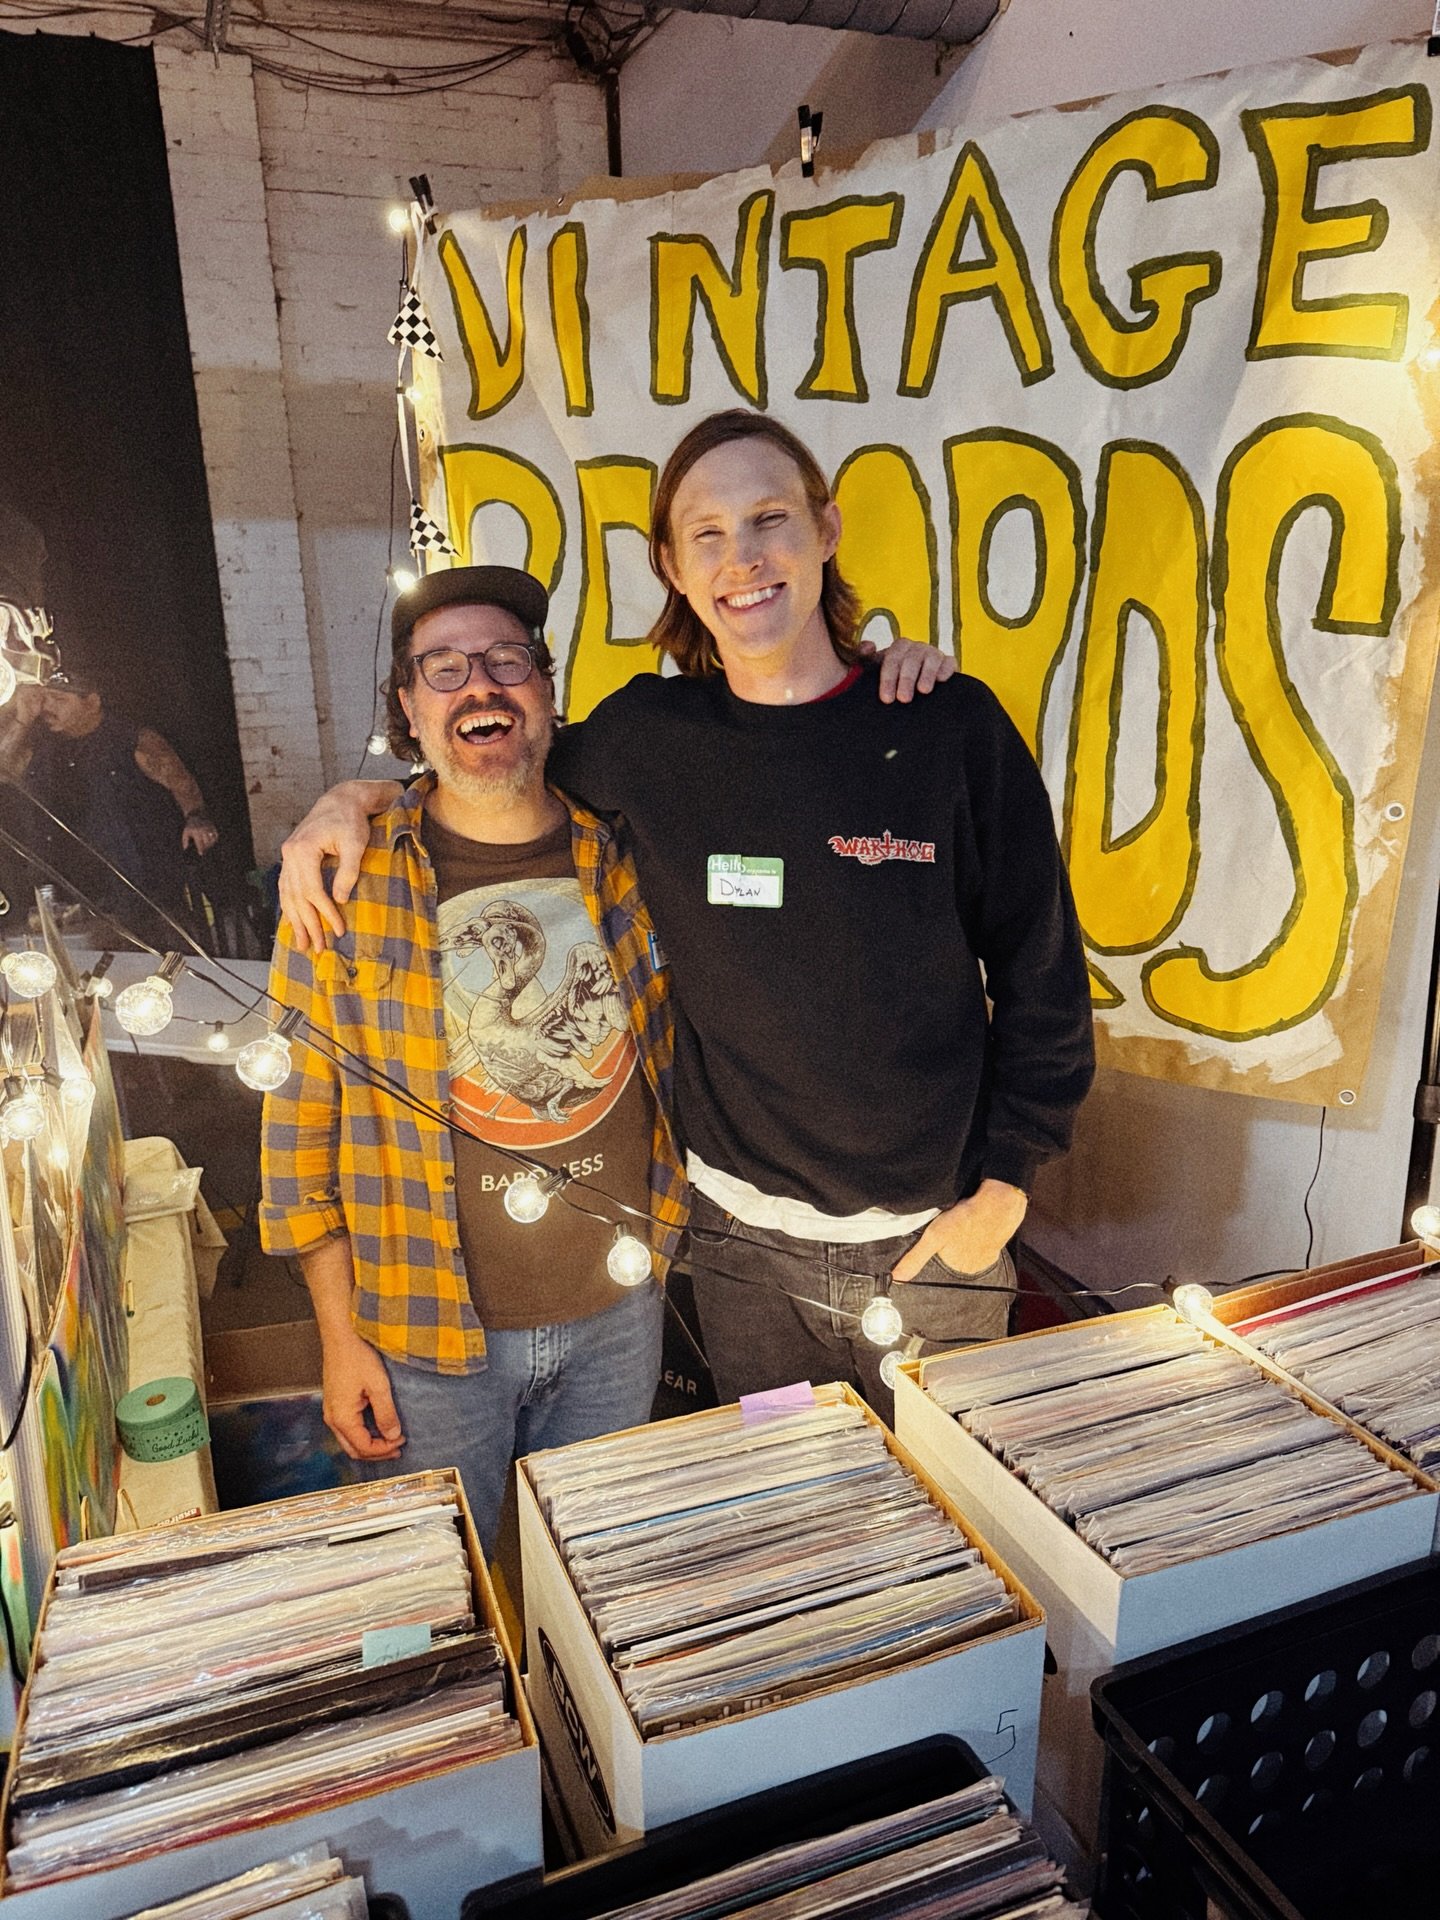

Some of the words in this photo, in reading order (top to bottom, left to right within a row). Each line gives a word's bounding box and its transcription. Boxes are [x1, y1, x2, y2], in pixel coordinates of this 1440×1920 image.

[438, 82, 1432, 420] VINTAGE
[437, 411, 1402, 1043] ERDS
[710, 857, 747, 873] Hello
[828, 829, 936, 866] WARTHOG
[480, 1153, 605, 1192] BAESS
[551, 1661, 598, 1782] BCW
[983, 1708, 1019, 1765] 5
